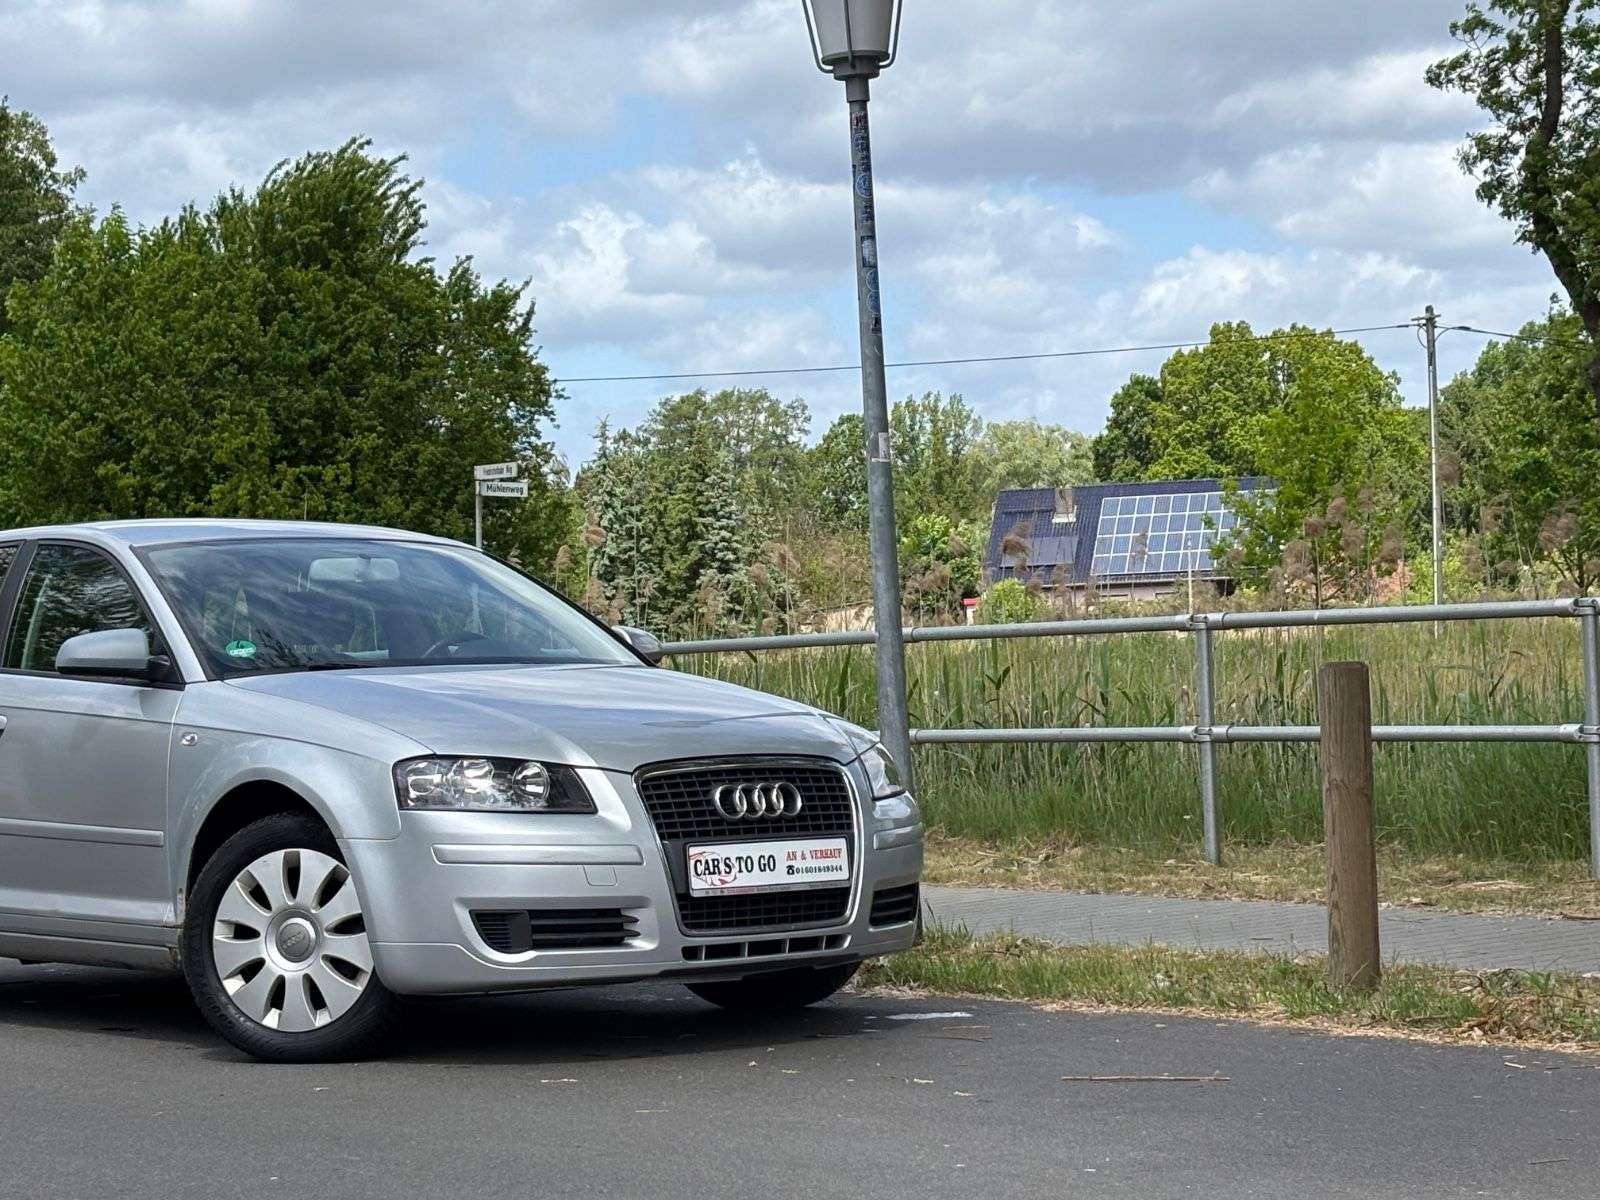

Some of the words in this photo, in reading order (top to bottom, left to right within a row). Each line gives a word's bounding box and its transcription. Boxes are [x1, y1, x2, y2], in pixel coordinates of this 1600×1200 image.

[486, 483, 523, 495] Mühlenweg
[786, 850, 797, 861] AN
[801, 849, 807, 860] &
[809, 848, 843, 859] VERKAUF
[693, 857, 732, 876] CAR'S
[736, 855, 754, 873] TO
[758, 854, 777, 873] GO
